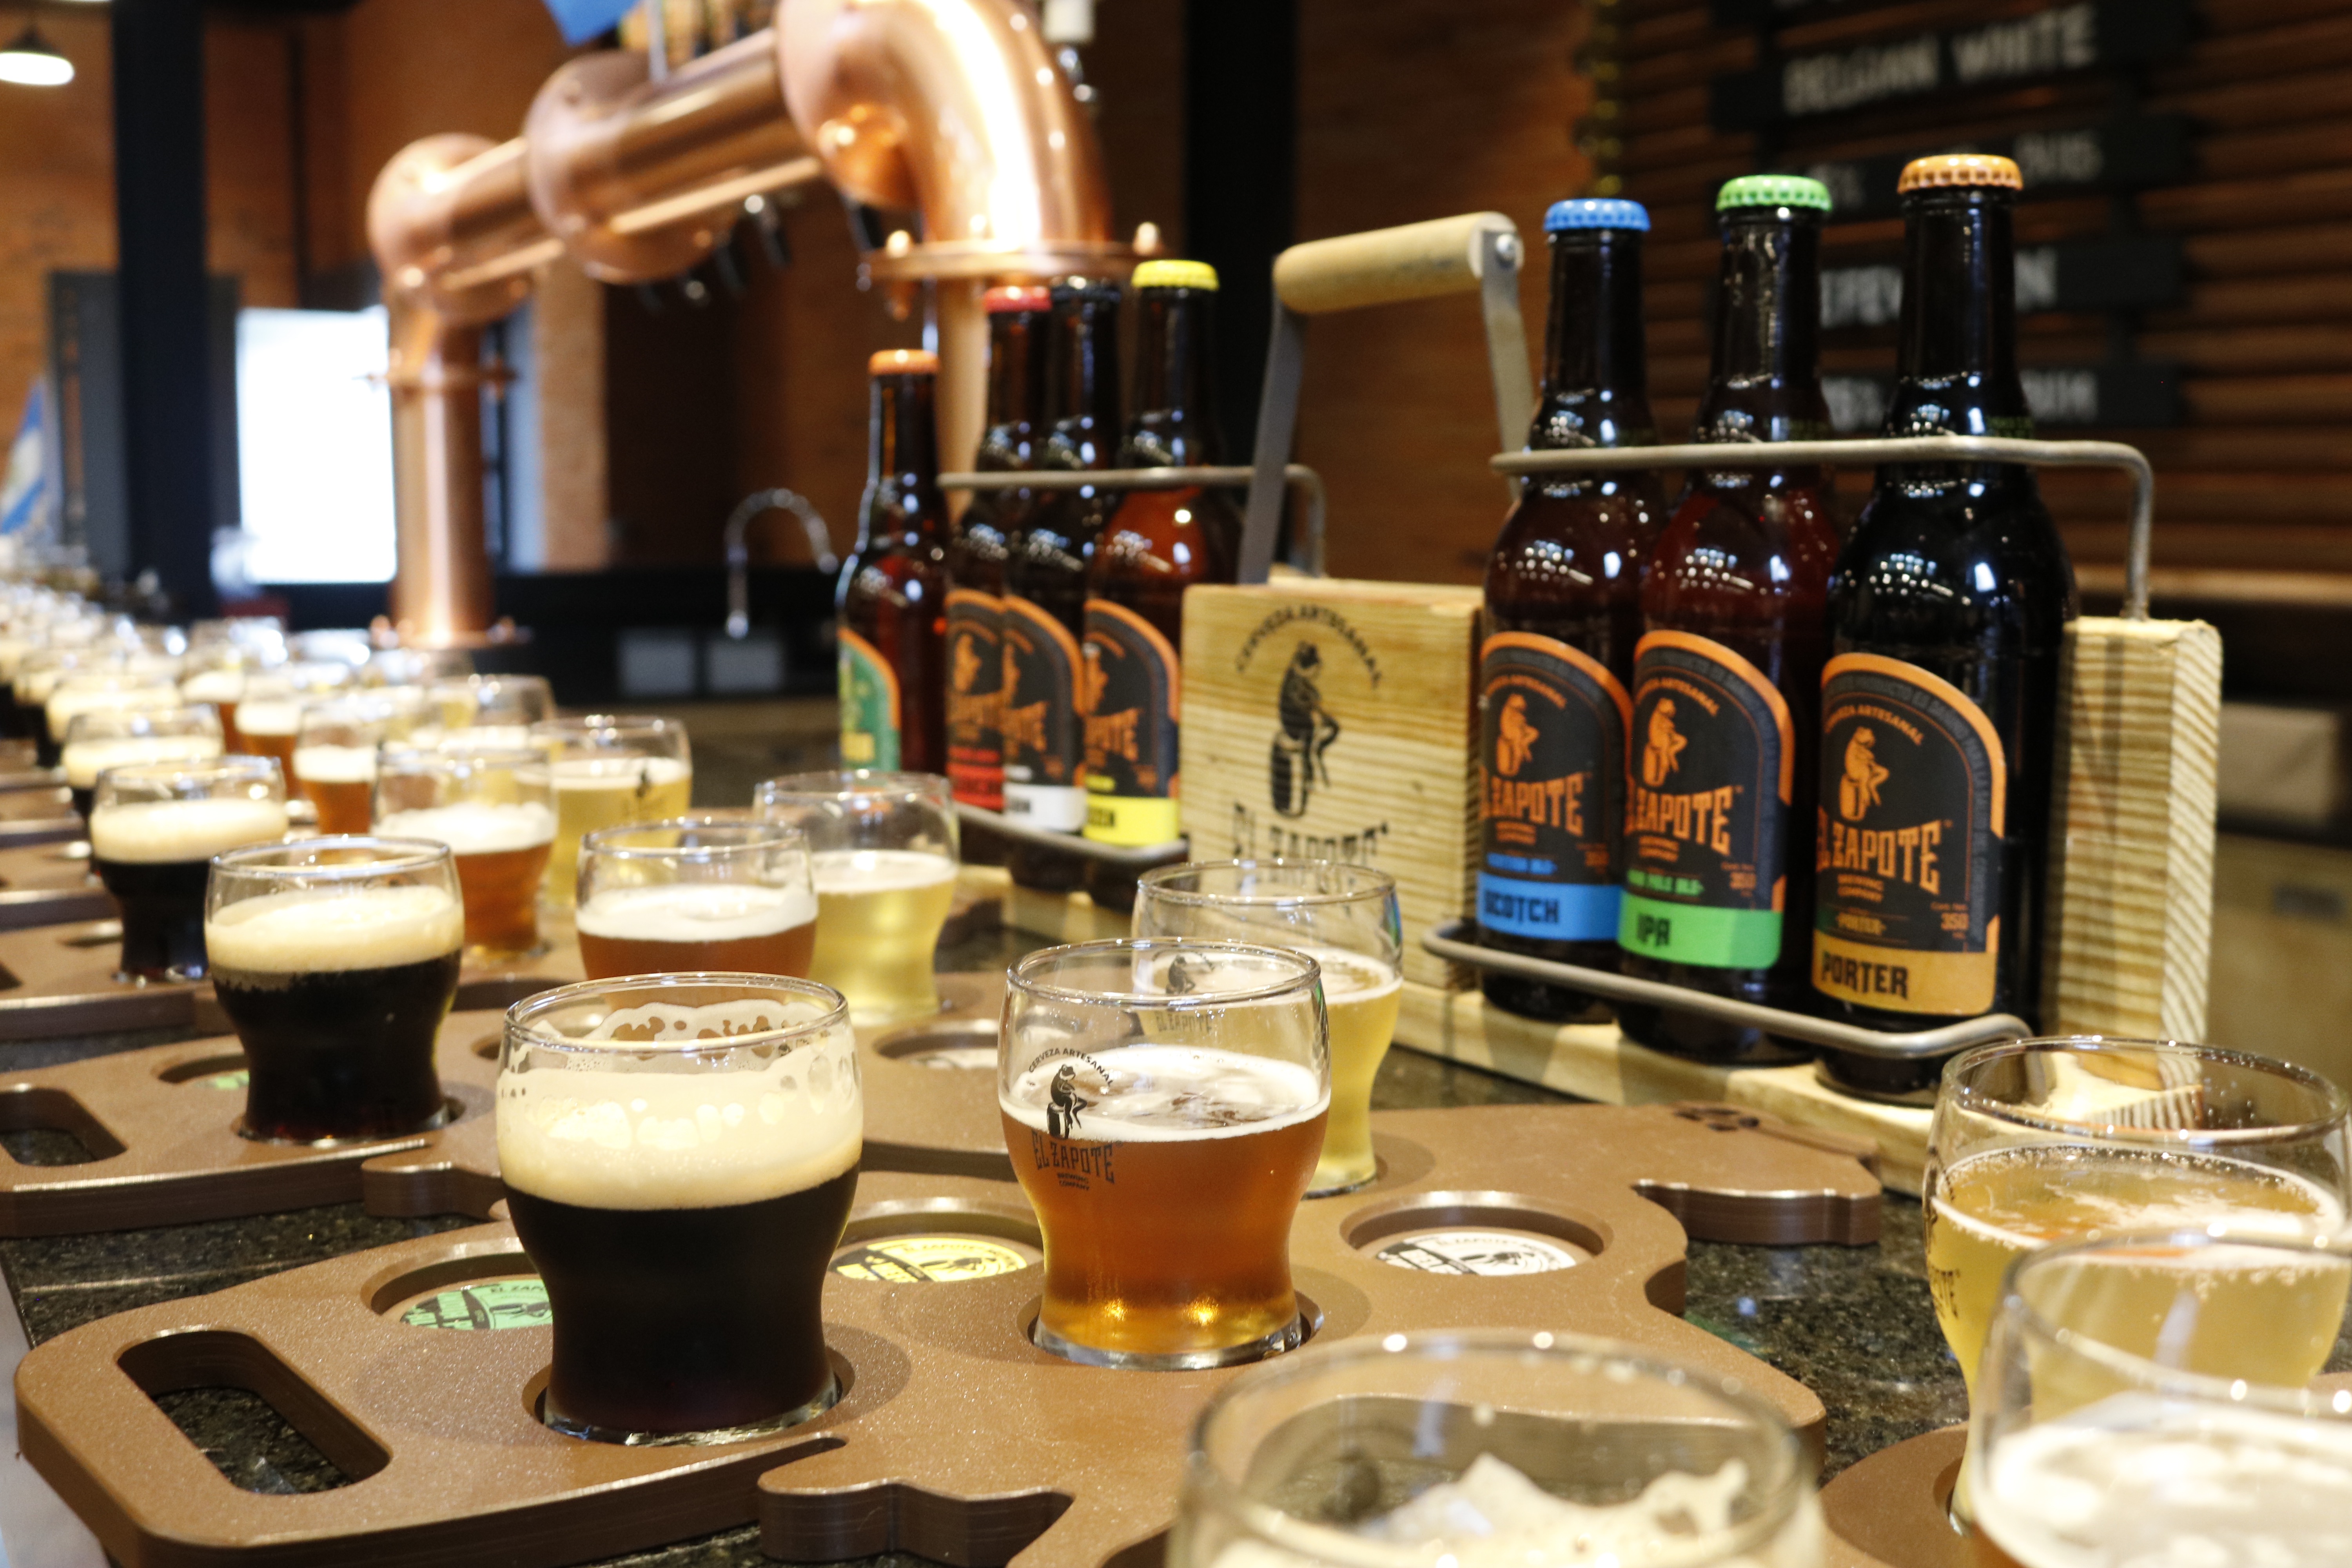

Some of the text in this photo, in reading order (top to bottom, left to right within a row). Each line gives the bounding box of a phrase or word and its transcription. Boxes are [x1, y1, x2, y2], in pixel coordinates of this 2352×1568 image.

[1831, 820, 1941, 895] ZAPOTE
[1636, 912, 1671, 948] IPA
[1821, 950, 1908, 1000] PORTER
[1029, 1047, 1114, 1087] CERVEZA ARTESANAL
[1031, 1129, 1115, 1185] EL ZAPOTE
[1059, 1180, 1090, 1191] COMPANY
